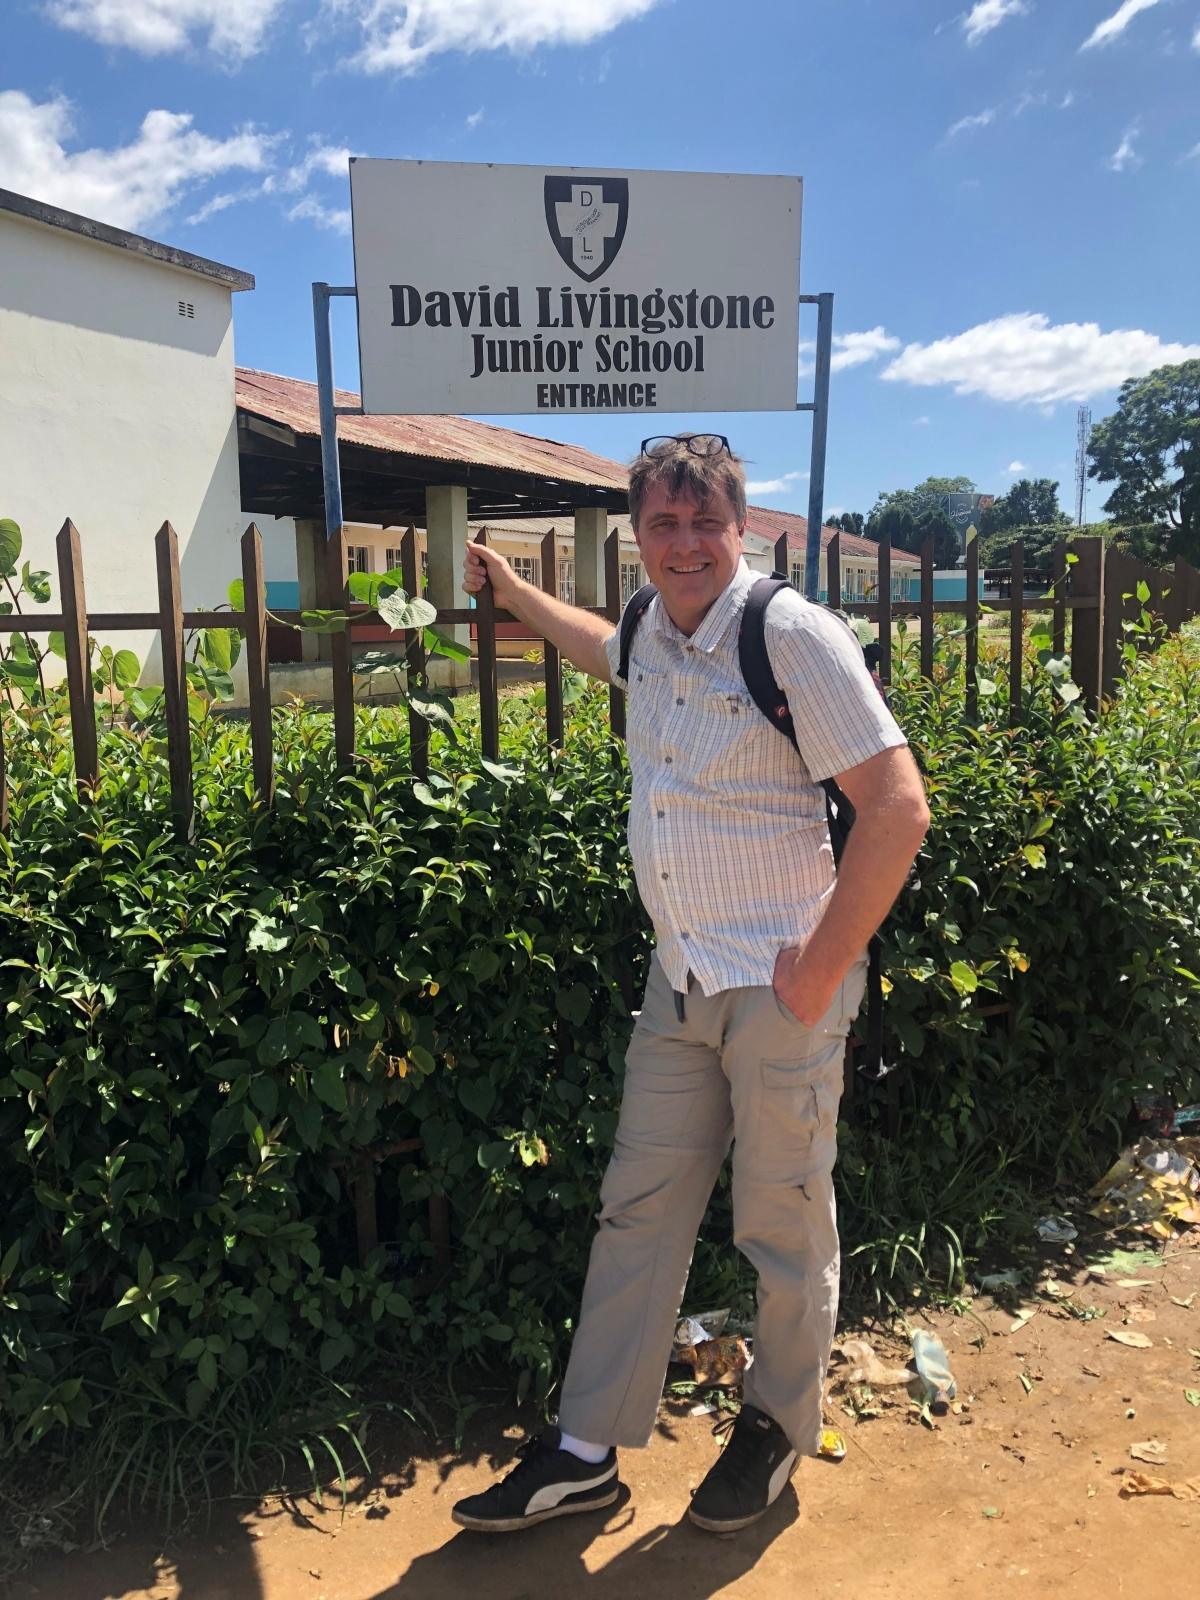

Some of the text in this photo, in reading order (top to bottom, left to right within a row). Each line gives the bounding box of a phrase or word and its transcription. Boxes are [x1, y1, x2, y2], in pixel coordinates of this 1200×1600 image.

[580, 190, 593, 207] D
[583, 236, 593, 253] L
[389, 284, 775, 335] David Livingstone
[469, 333, 705, 379] Junior School
[536, 383, 657, 409] ENTRANCE
